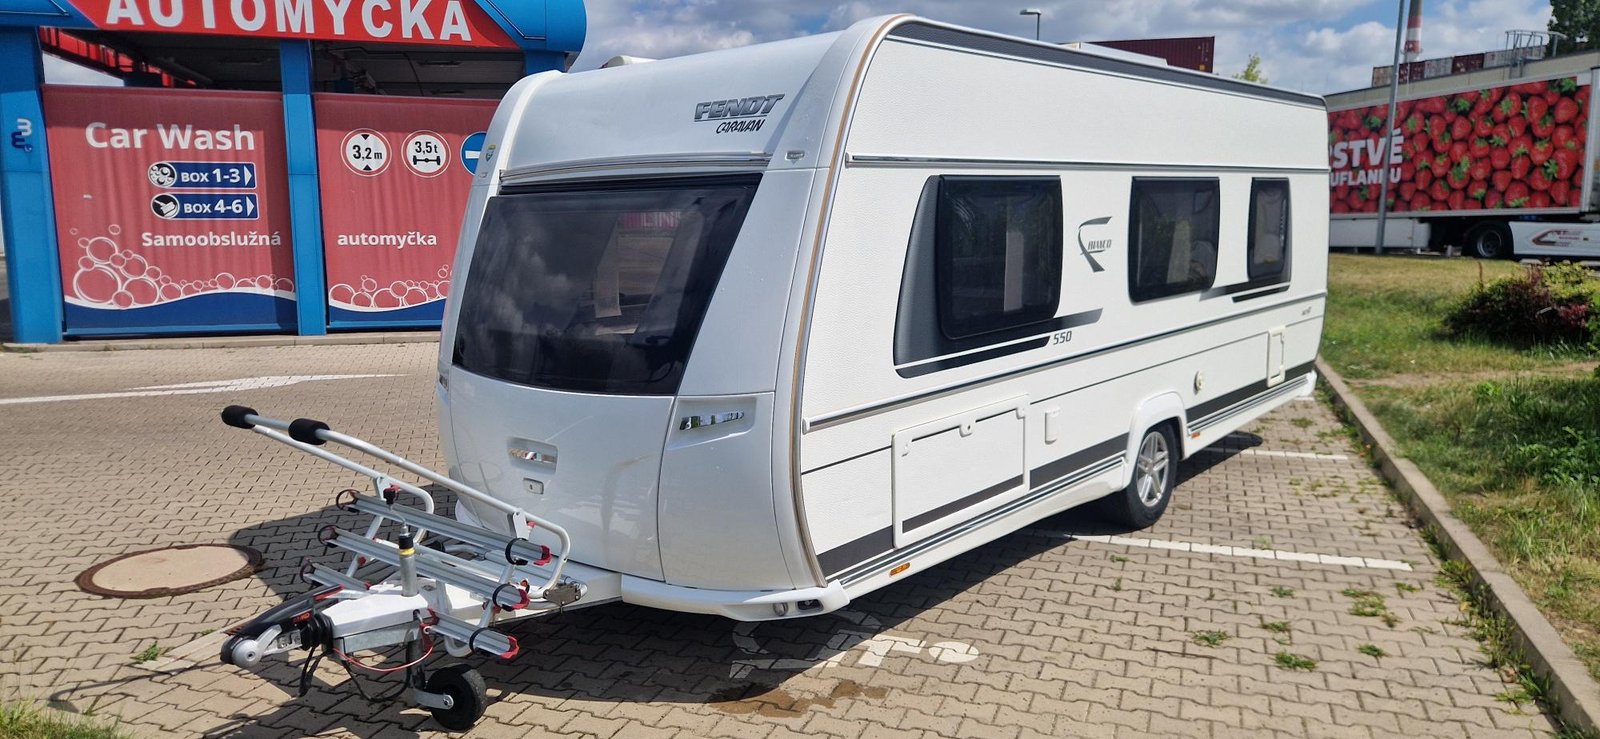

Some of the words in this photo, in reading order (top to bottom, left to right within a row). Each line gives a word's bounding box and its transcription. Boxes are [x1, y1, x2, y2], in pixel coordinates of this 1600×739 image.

[694, 94, 785, 121] FENDT
[716, 119, 765, 134] CARAVAN
[85, 122, 148, 148] Car
[157, 123, 254, 150] Wash
[352, 144, 372, 161] 3,2
[374, 151, 382, 159] m
[414, 141, 432, 154] 3,5
[1328, 128, 1404, 169] STVÉ
[181, 172, 209, 183] BOX
[212, 168, 240, 183] 1-3
[183, 203, 211, 214] BOX
[214, 199, 243, 214] 4-6
[141, 231, 281, 247] Samoobslužná
[337, 231, 437, 249] automyčka
[1053, 330, 1073, 346] 550
